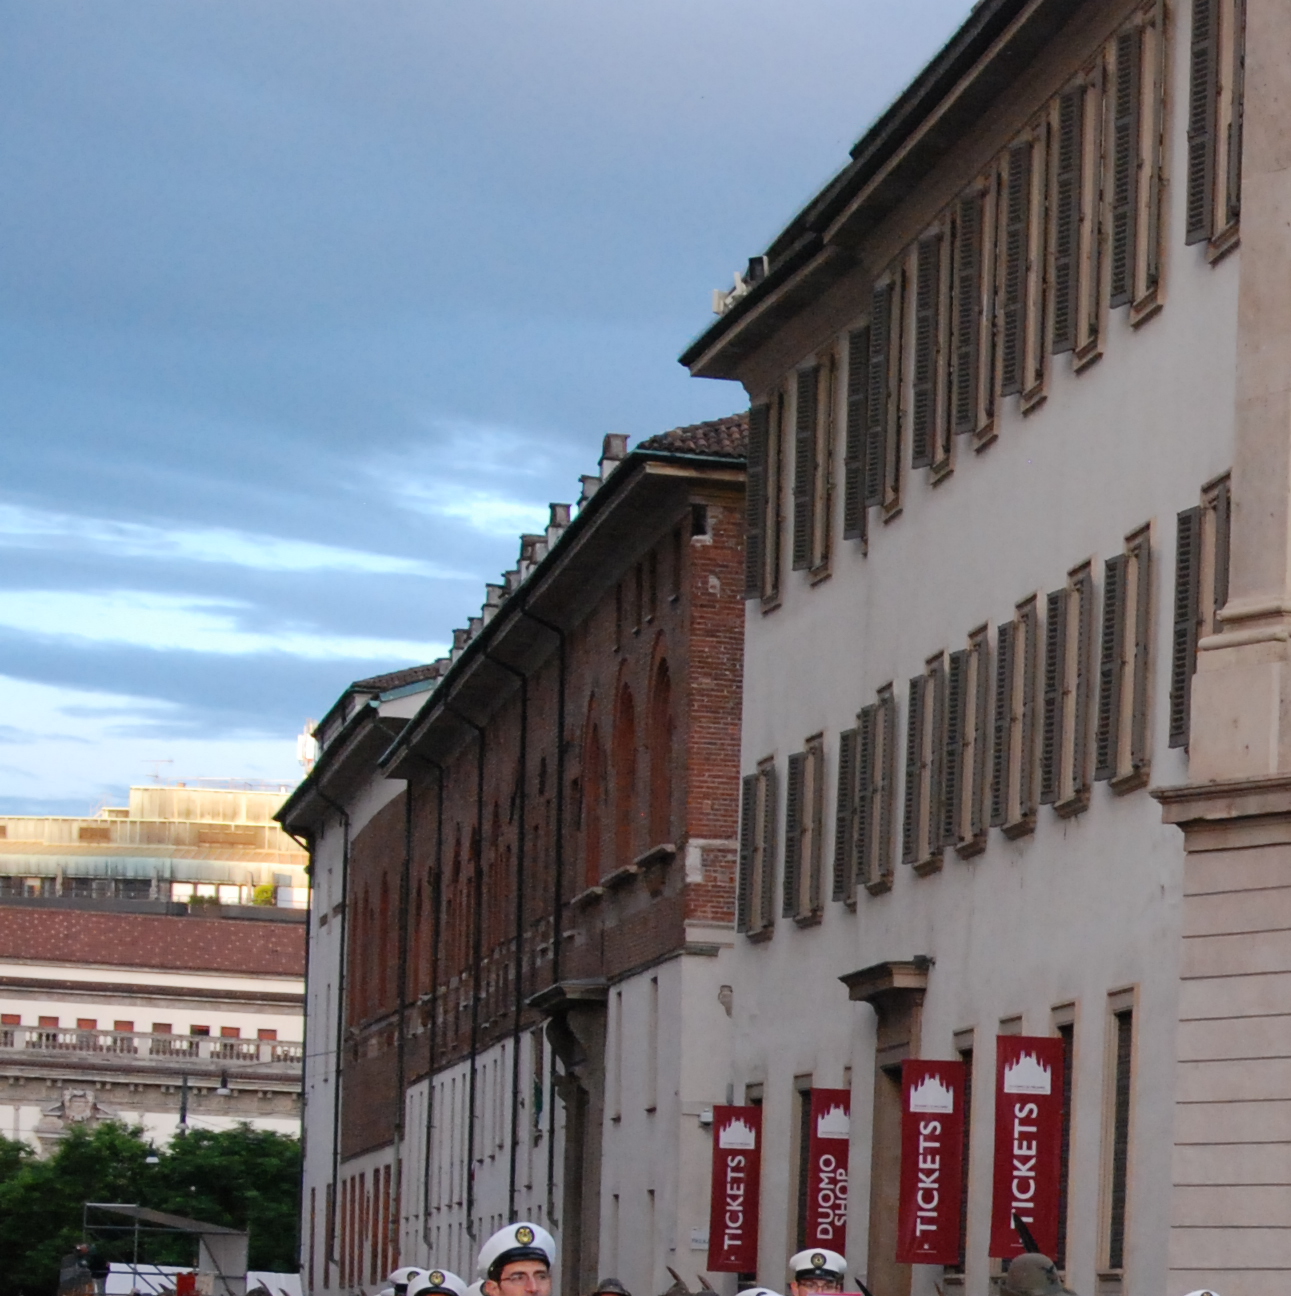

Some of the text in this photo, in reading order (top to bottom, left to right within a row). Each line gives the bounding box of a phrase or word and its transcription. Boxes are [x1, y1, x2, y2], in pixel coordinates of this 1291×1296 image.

[723, 1155, 746, 1250] TICKETS
[816, 1154, 836, 1239] DUOMO
[834, 1168, 849, 1227] SHOP
[915, 1120, 942, 1237] TICKETS
[1010, 1102, 1038, 1229] TICKETS
